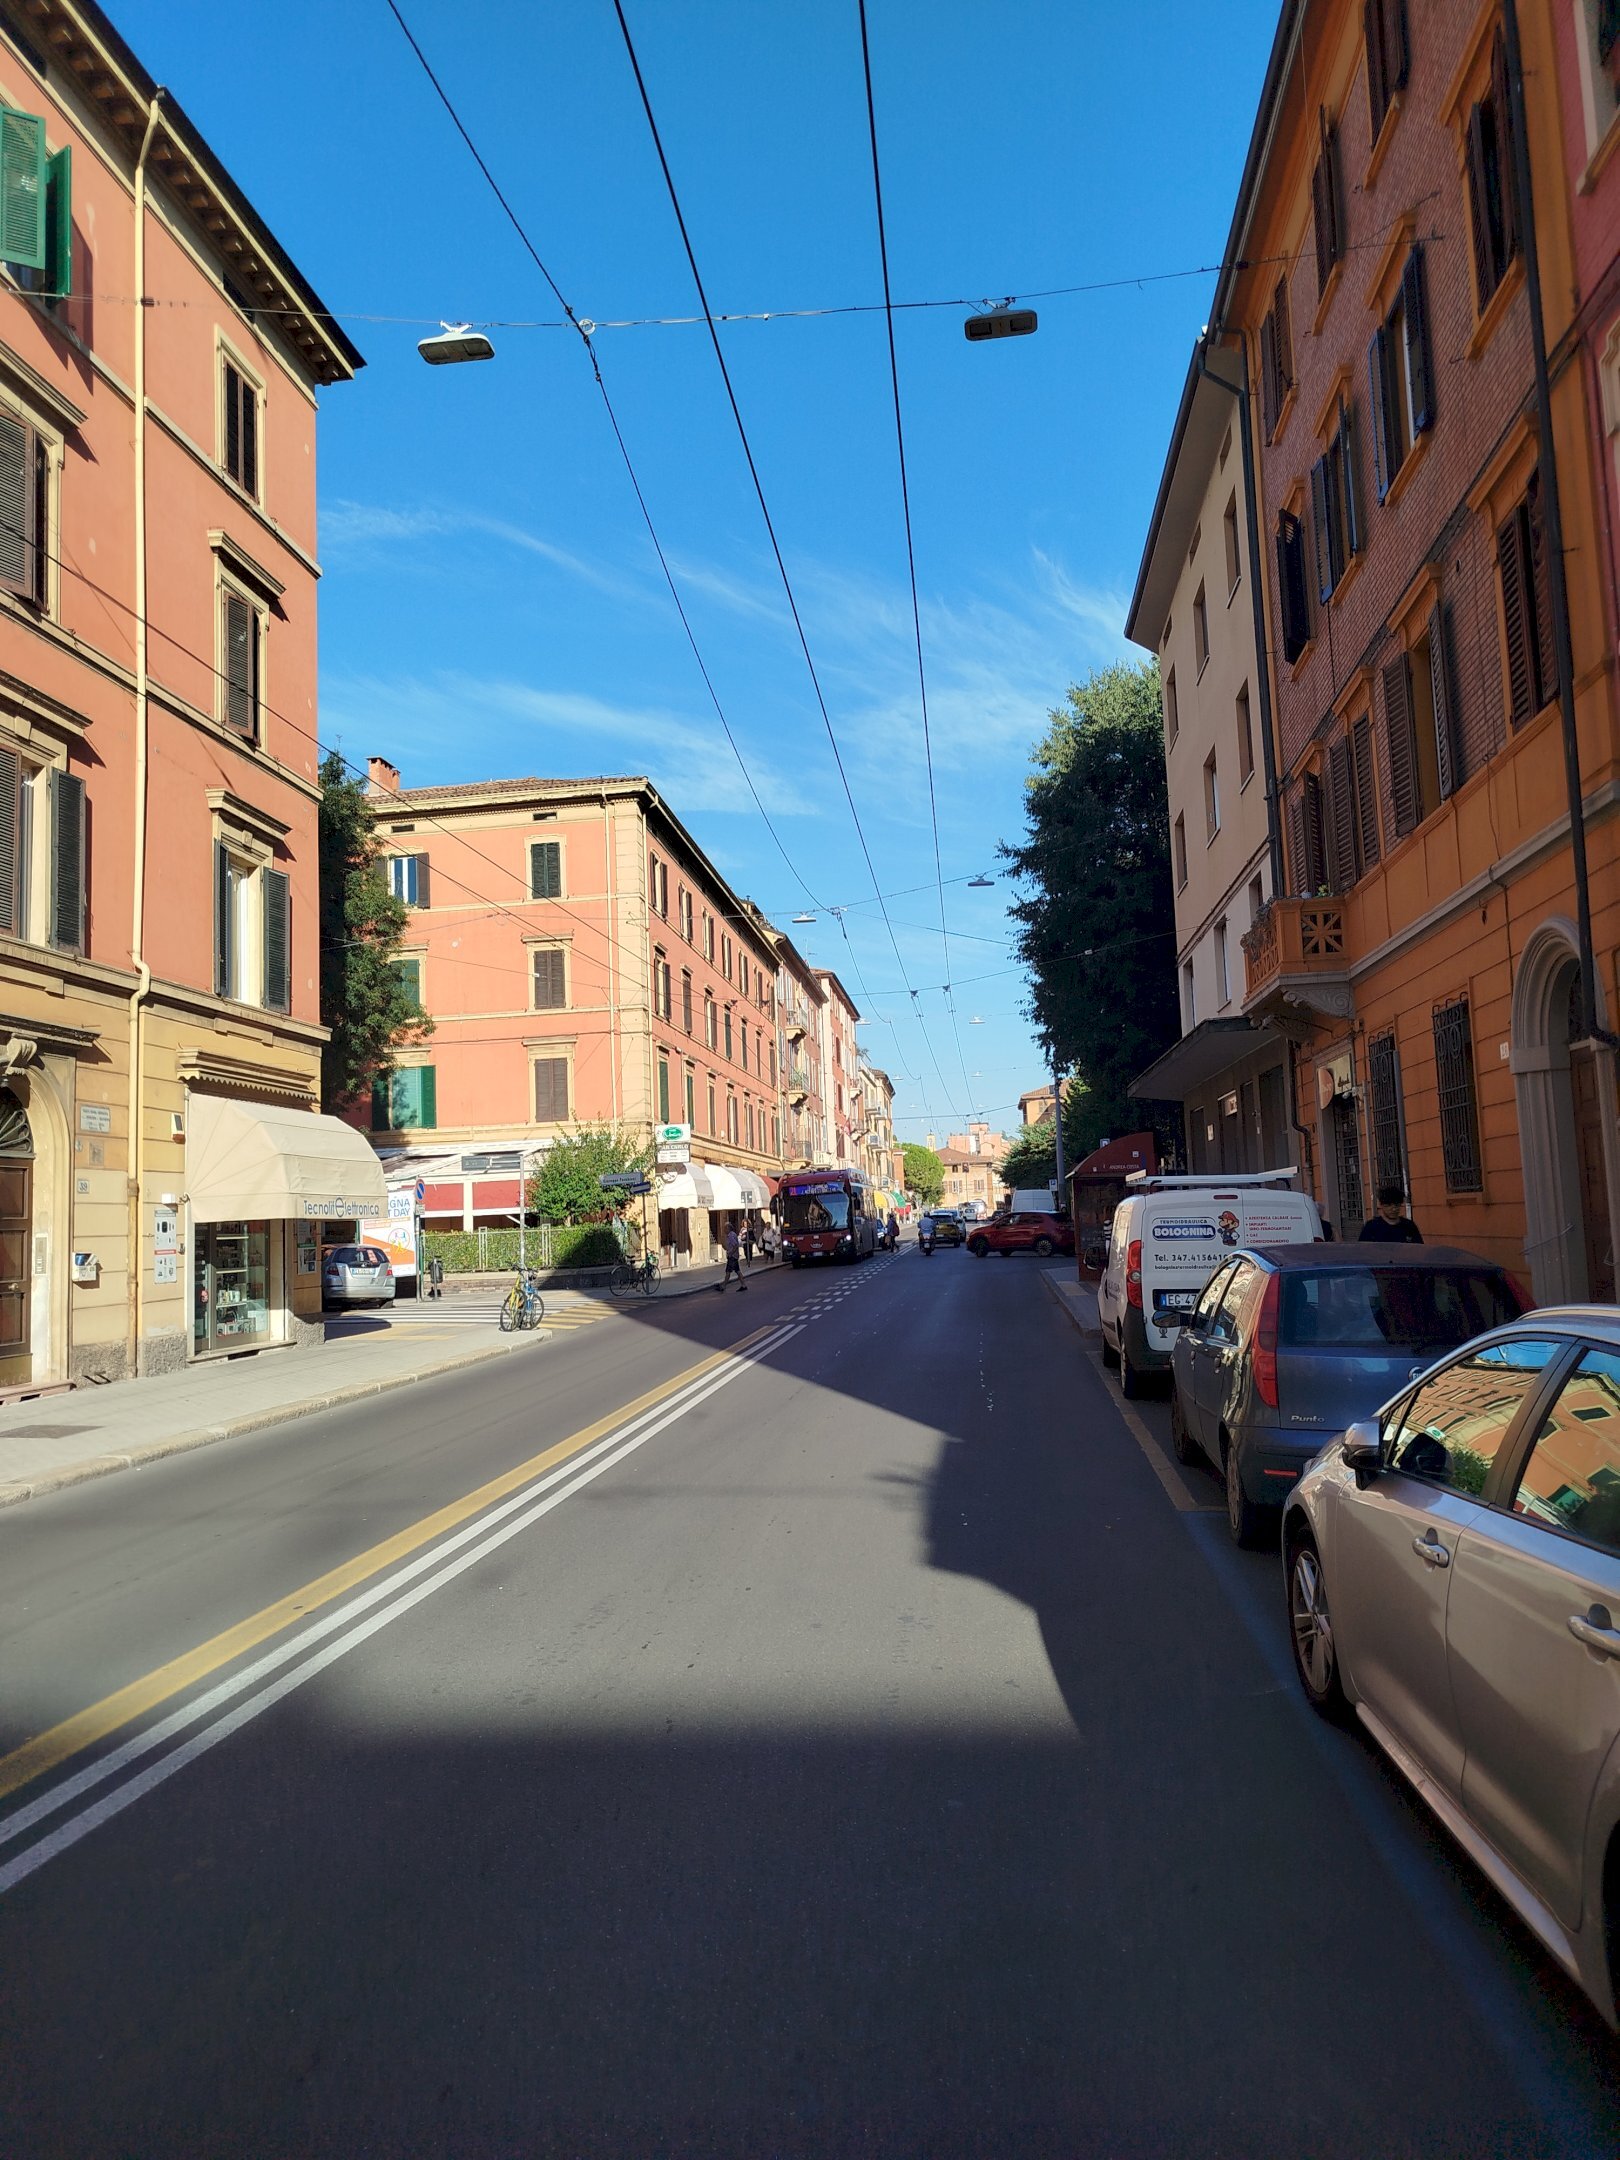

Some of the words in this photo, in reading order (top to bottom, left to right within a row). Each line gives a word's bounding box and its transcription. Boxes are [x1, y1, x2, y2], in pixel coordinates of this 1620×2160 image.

[389, 1198, 411, 1208] GNA
[393, 1207, 411, 1217] DAY
[1154, 1227, 1215, 1237] BOLOGNINA
[1154, 1254, 1169, 1262] Tel.
[1167, 1294, 1181, 1305] EG
[1184, 1294, 1198, 1305] 47
[1291, 1415, 1325, 1423] Punto
